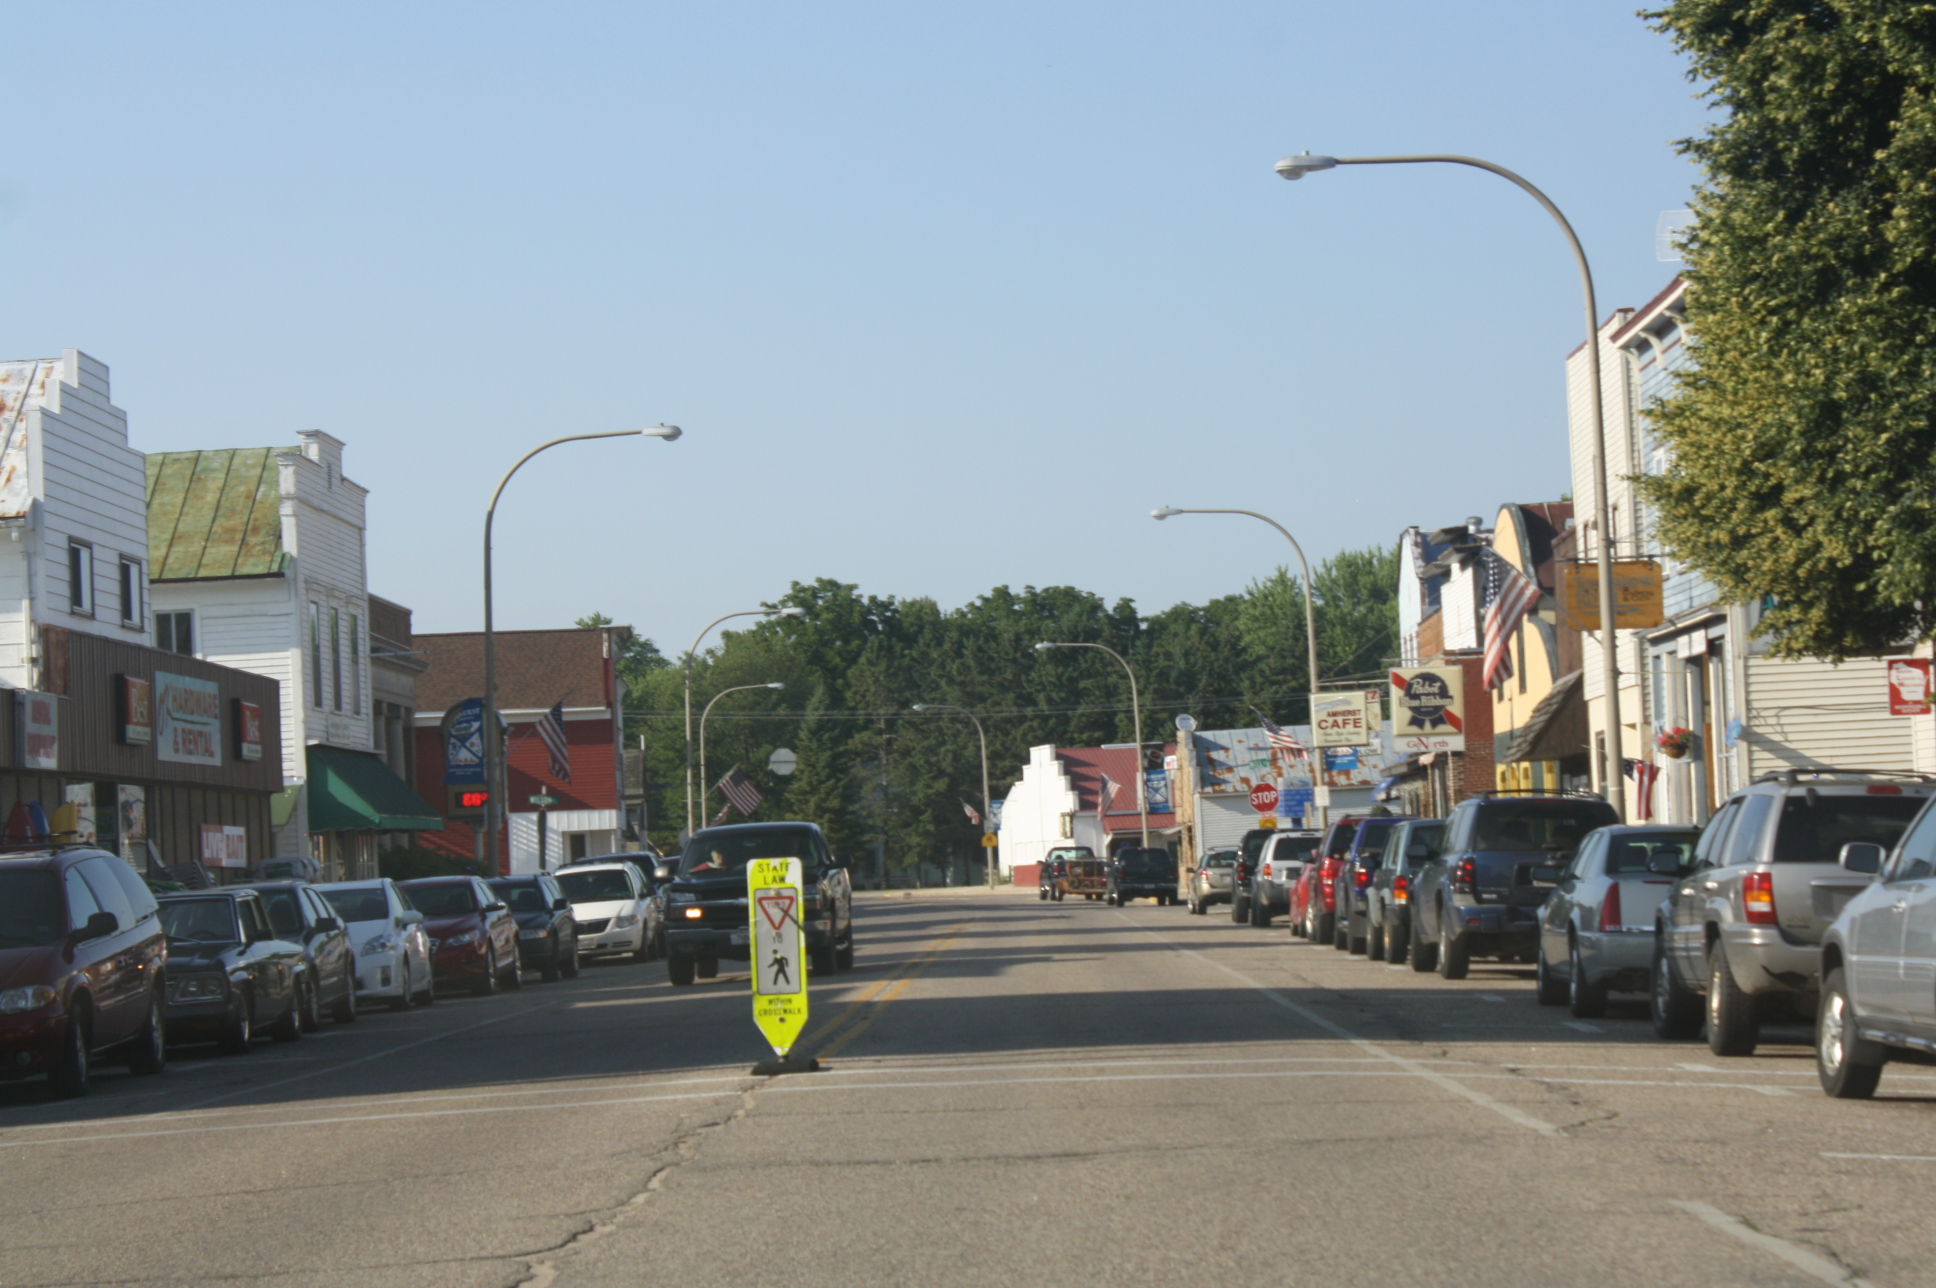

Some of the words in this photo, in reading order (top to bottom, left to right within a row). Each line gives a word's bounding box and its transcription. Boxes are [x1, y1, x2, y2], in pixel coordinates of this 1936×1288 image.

[1410, 678, 1441, 694] Pabst
[171, 686, 218, 719] HARDWARE
[1327, 709, 1361, 717] AMHERST
[1318, 718, 1362, 730] CAFE
[172, 726, 180, 754] &
[181, 727, 215, 758] RENTAL
[1251, 791, 1278, 804] STOP
[203, 832, 224, 858] LIVE
[225, 834, 244, 859] BAIT
[758, 863, 790, 873] STATE
[764, 876, 786, 885] LAW
[758, 1008, 801, 1016] CROSSWALK
